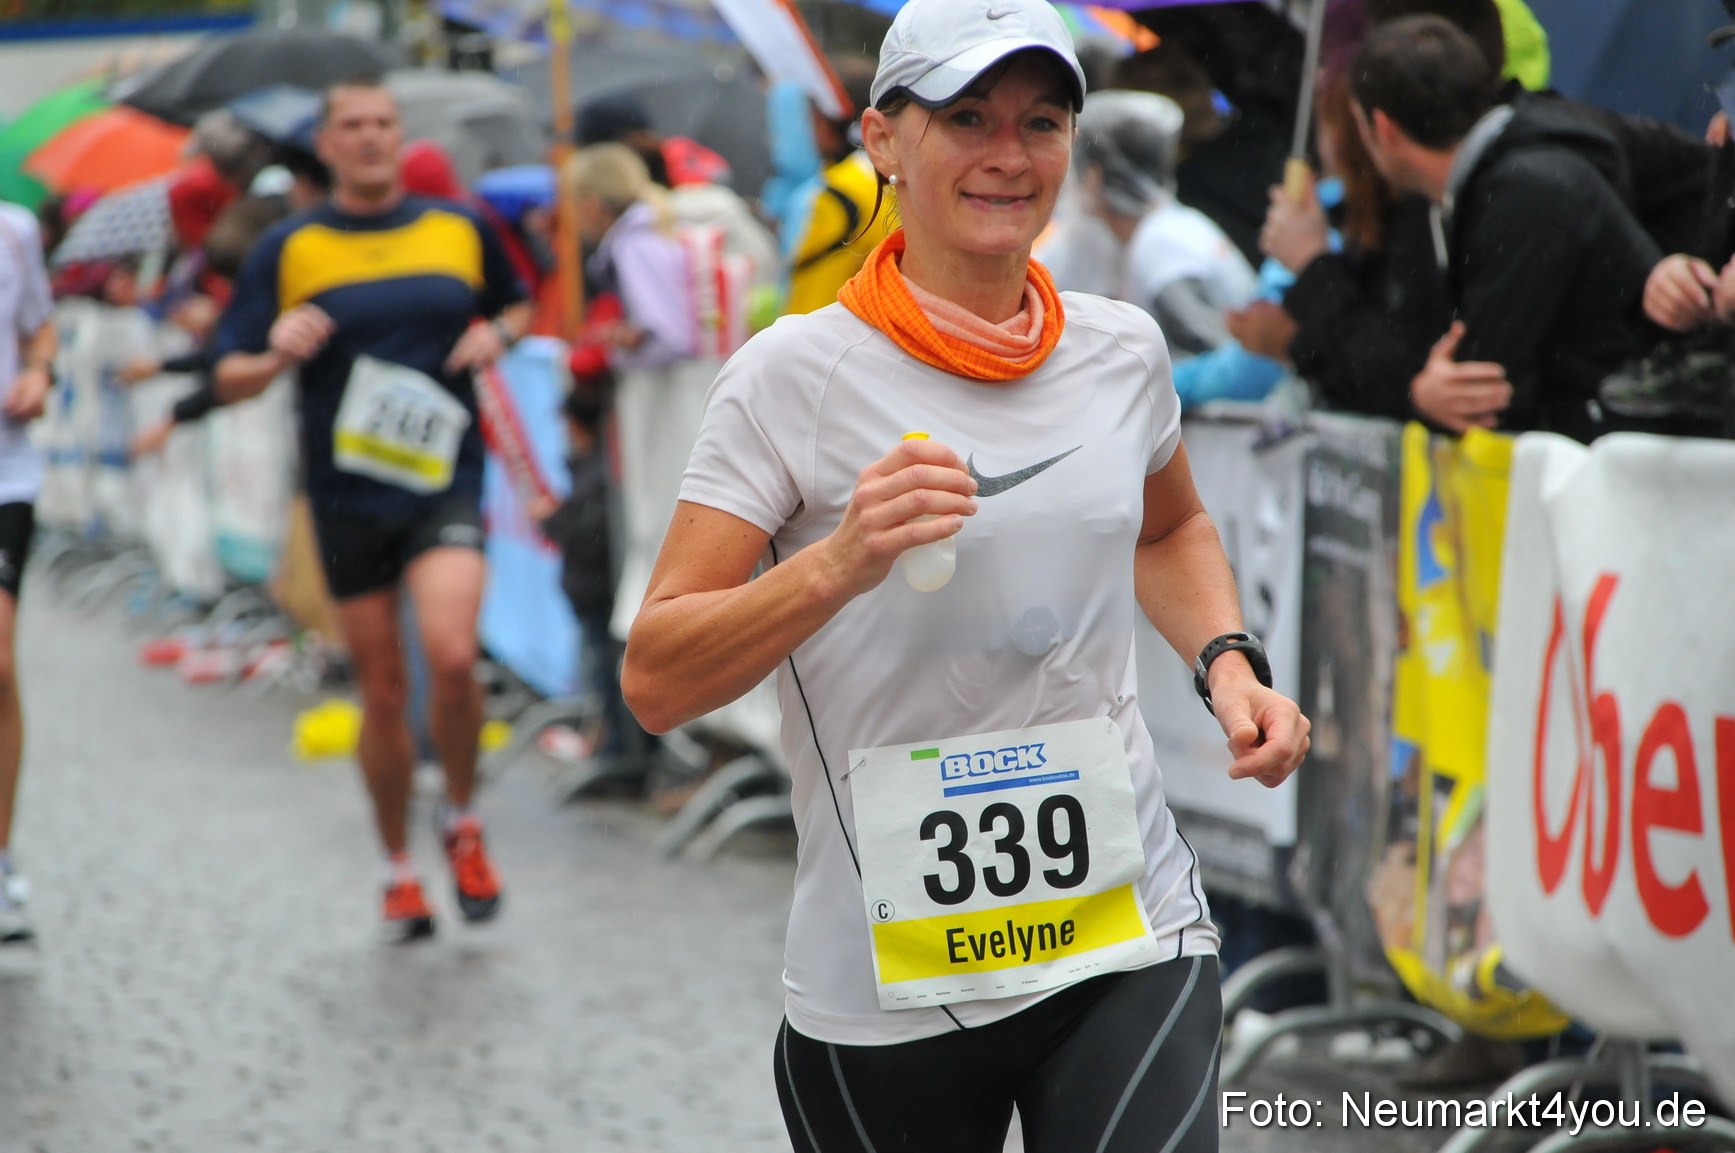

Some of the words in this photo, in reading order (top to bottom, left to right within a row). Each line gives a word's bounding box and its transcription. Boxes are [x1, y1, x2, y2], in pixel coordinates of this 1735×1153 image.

[940, 743, 1047, 781] BOCK
[1028, 772, 1076, 783] www.bockonline.de
[919, 794, 1090, 905] 339
[878, 903, 888, 919] C
[945, 919, 1075, 964] Evelyne
